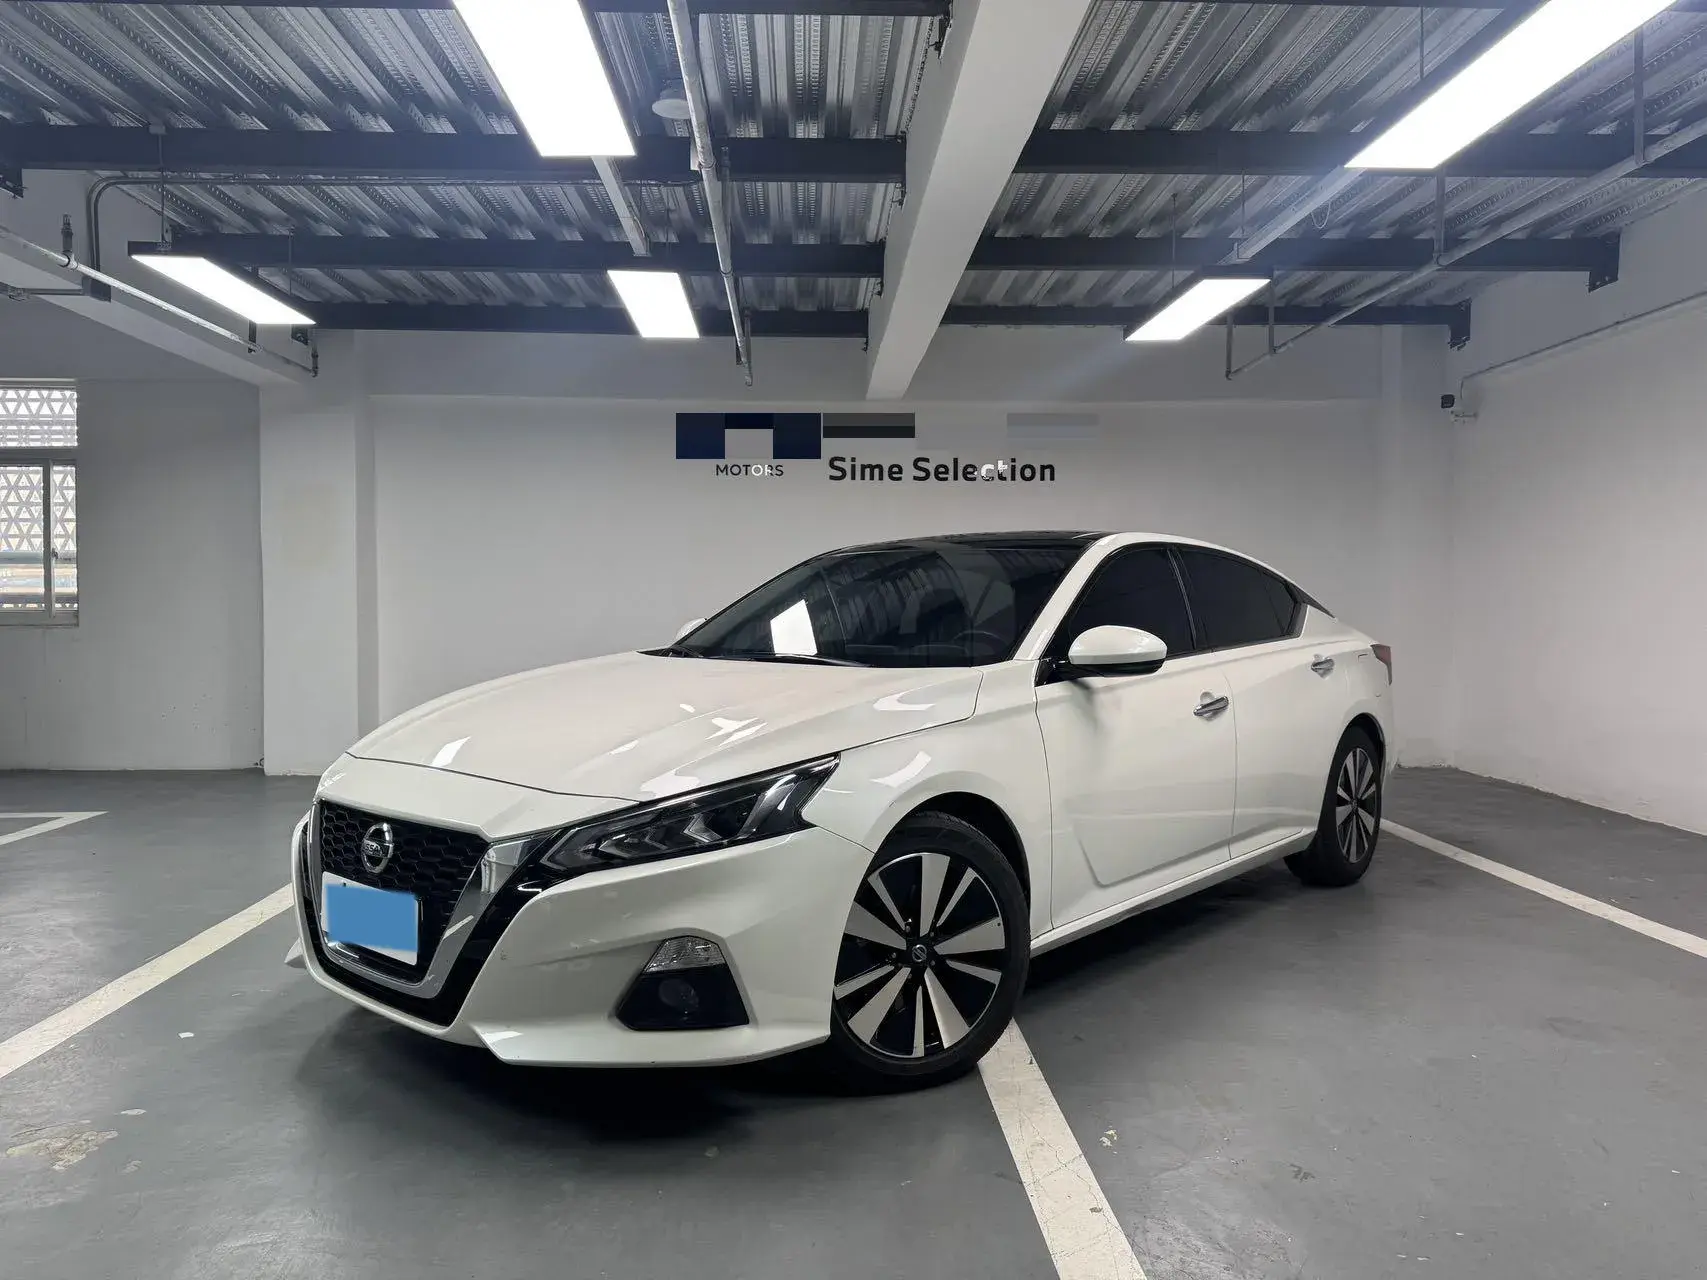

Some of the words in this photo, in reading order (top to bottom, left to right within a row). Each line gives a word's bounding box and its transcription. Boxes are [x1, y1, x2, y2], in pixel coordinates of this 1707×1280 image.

[716, 464, 784, 476] MOTORS
[829, 456, 903, 481] Sime
[913, 456, 1056, 481] Selection
